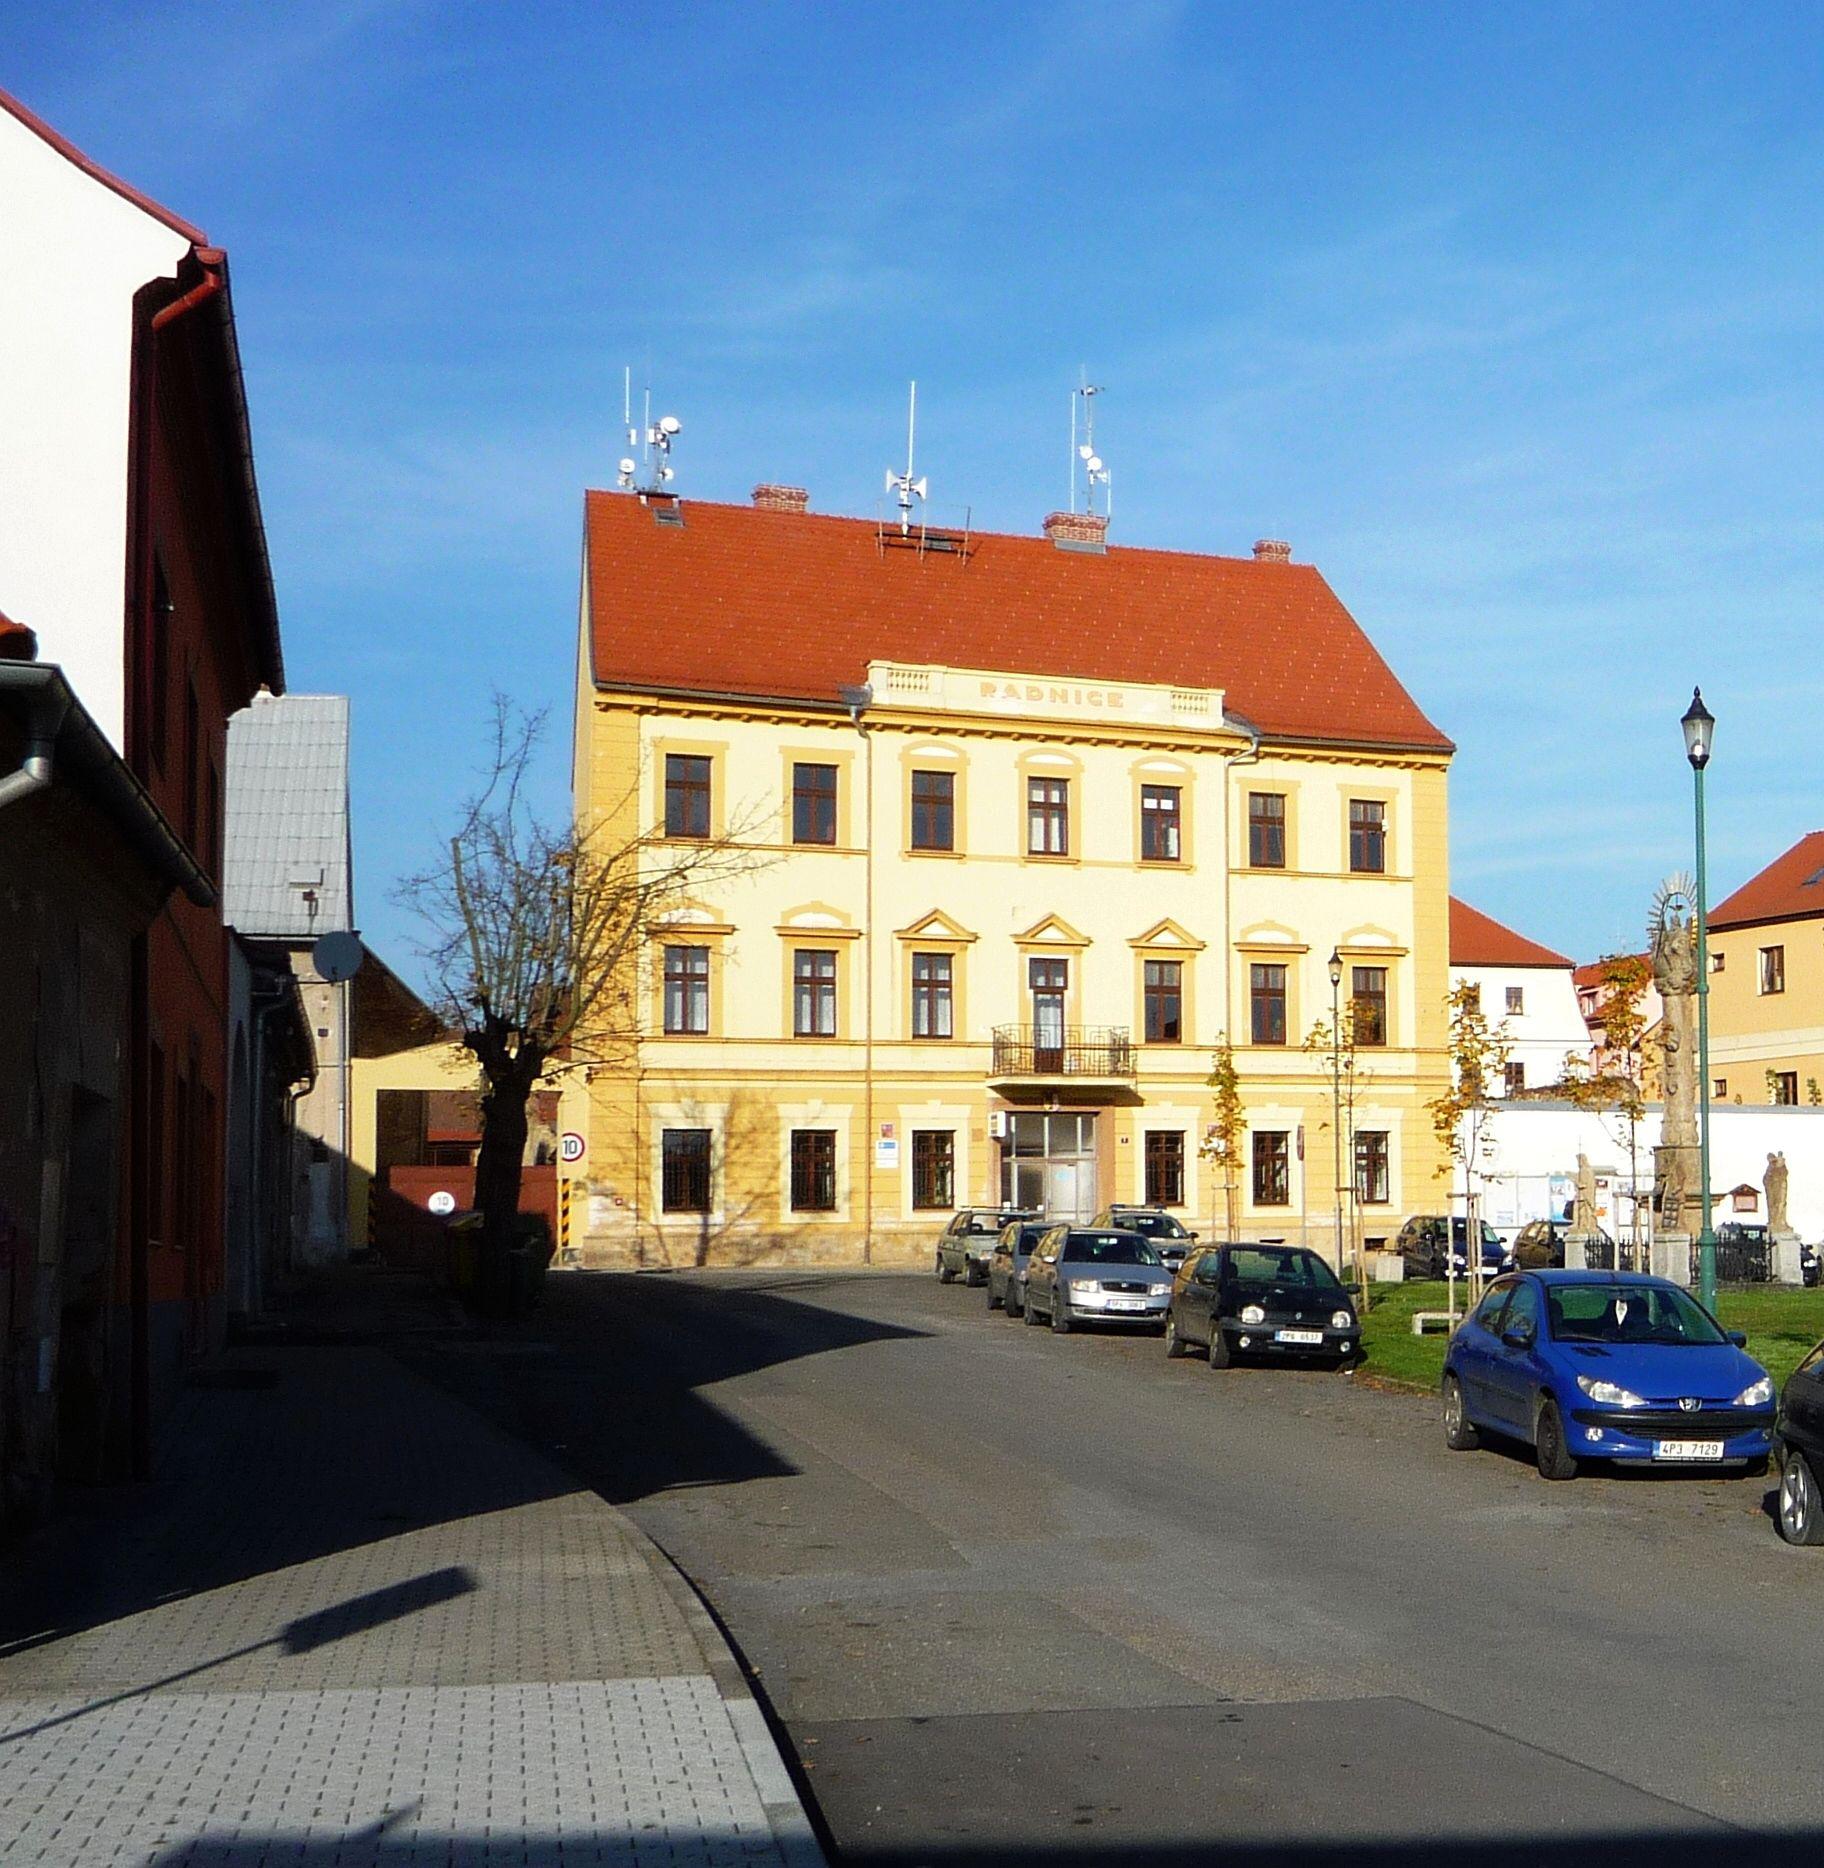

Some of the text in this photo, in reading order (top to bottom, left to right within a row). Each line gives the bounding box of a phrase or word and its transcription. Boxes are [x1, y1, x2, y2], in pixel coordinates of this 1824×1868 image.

[979, 681, 1124, 708] RADNICE
[563, 1140, 578, 1155] 10
[1662, 1443, 1718, 1456] 4P3 7129
